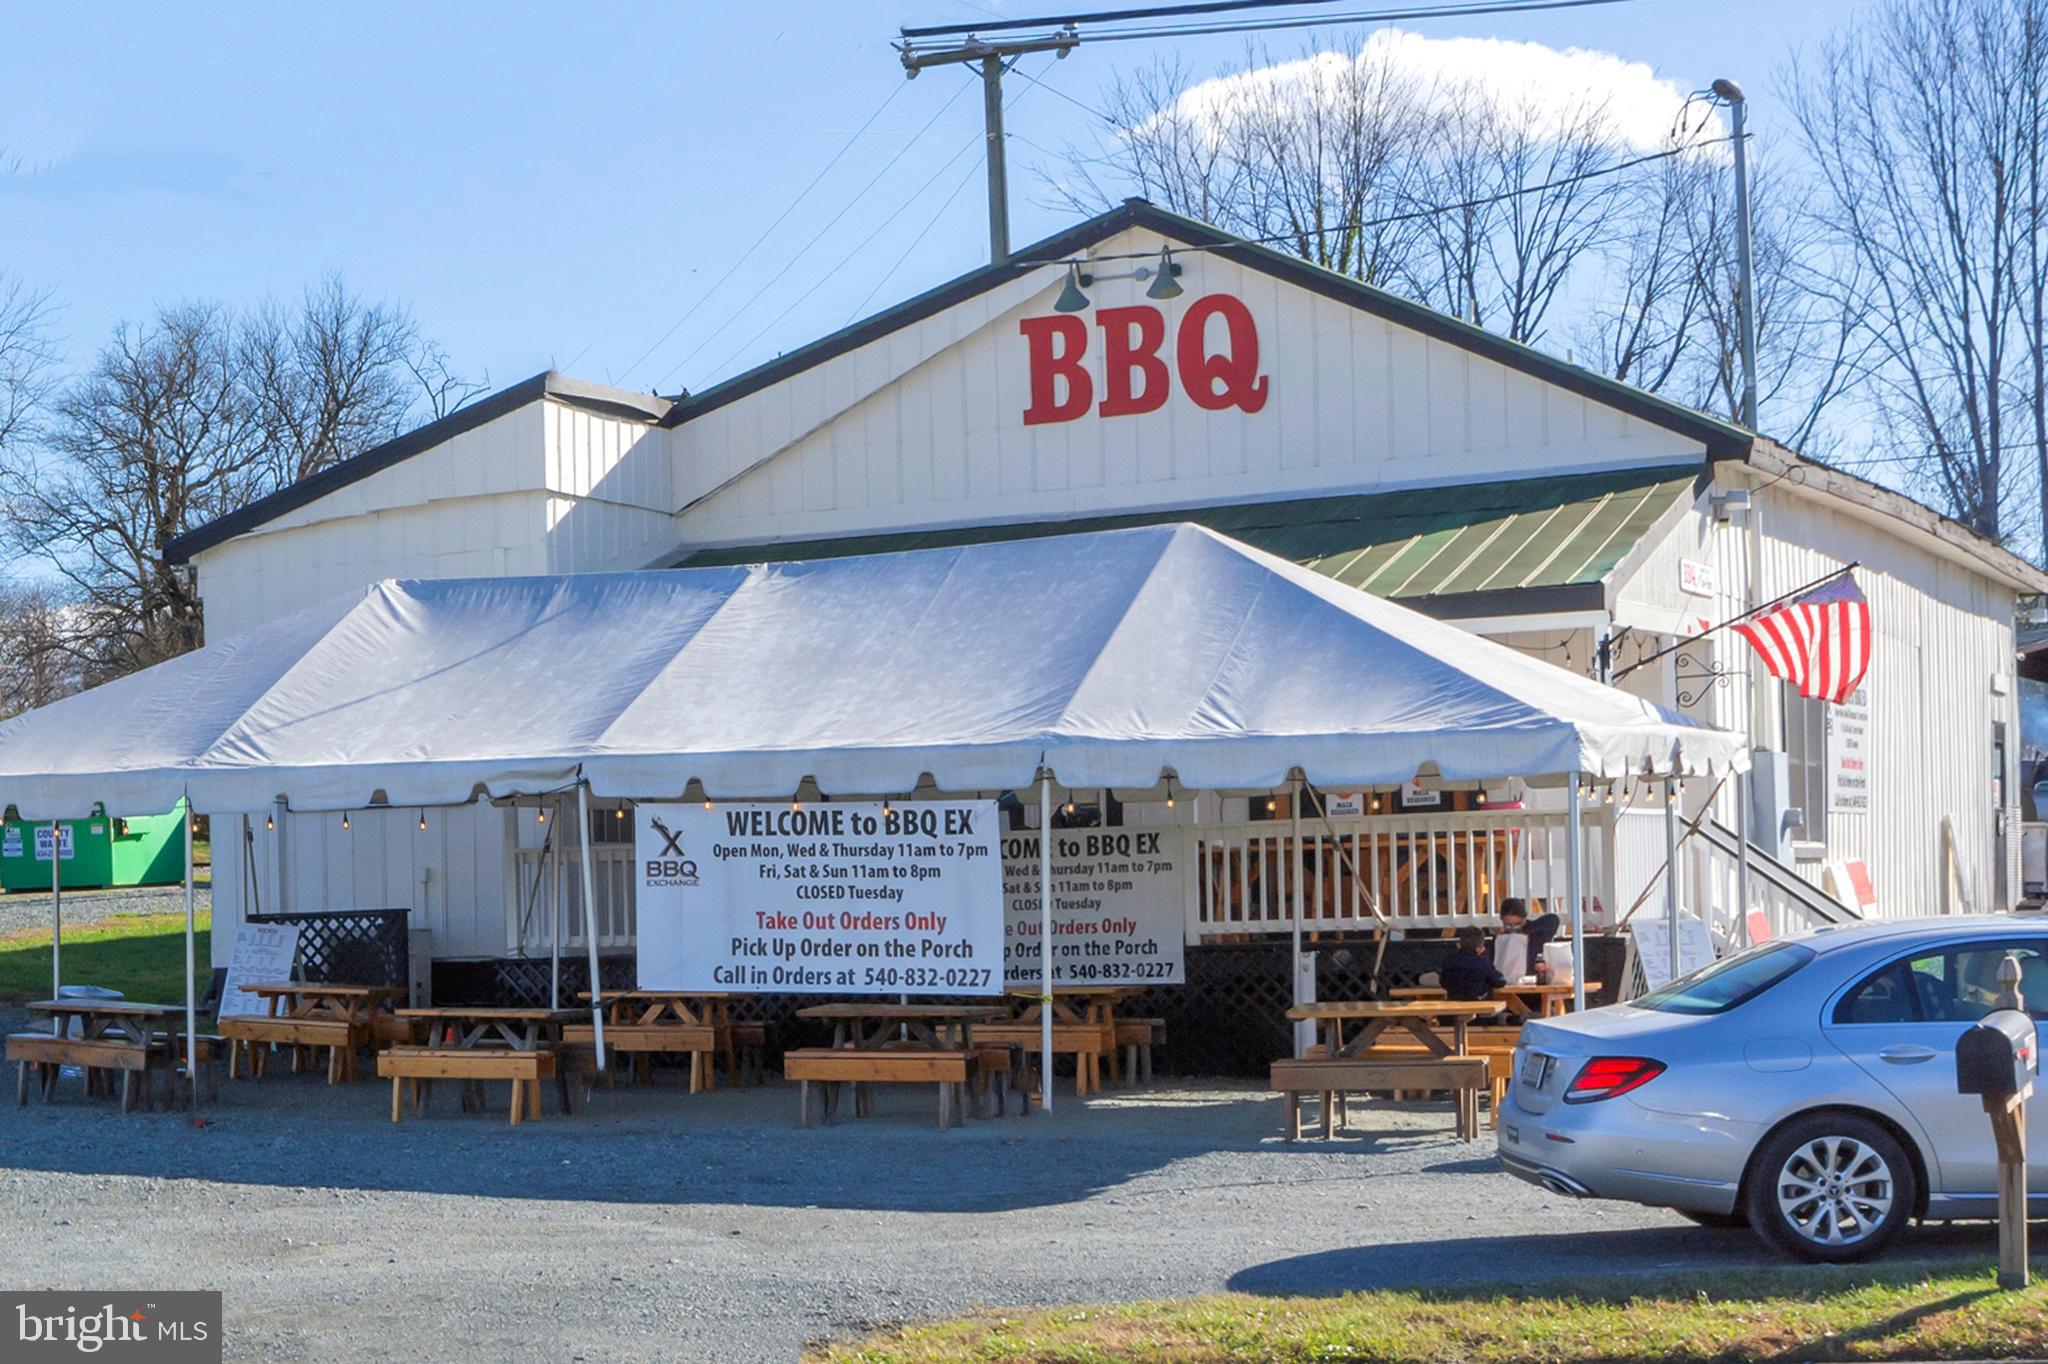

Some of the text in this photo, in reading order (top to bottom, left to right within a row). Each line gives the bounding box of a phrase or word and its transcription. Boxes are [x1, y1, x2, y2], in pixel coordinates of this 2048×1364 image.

[1019, 294, 1269, 426] BBQ
[726, 809, 974, 839] WELCOME to BBQ EX
[37, 829, 70, 839] COUTY
[713, 843, 989, 861] Open Mon, Wed & Thursday 11am to 7pm
[1058, 838, 1081, 858] to
[1086, 834, 1131, 858] BBQ
[1136, 832, 1160, 854] EX
[646, 861, 700, 881] BBQ
[759, 864, 941, 881] Fri, Sat & Sun 11am to 8pm
[1005, 860, 1173, 877] Wed & hursday 11am to 7pm
[796, 885, 904, 903] CLOSED Tuesday
[1003, 879, 1133, 894] Sat & Sn 11am to 8pm
[1012, 898, 1102, 911] CLOS Tuesday
[755, 911, 947, 936] Take Out Orders Only
[1102, 917, 1137, 936] Only
[731, 937, 973, 961] Pick Up Order on the Porch
[1015, 942, 1058, 957] Ordr
[1061, 944, 1080, 957] on
[1085, 940, 1109, 956] the
[1115, 939, 1158, 955] Porch
[713, 965, 991, 987] Call in Orders at 540-832-0227
[1003, 965, 1043, 980] rders
[1070, 962, 1174, 980] 540-832-0227
